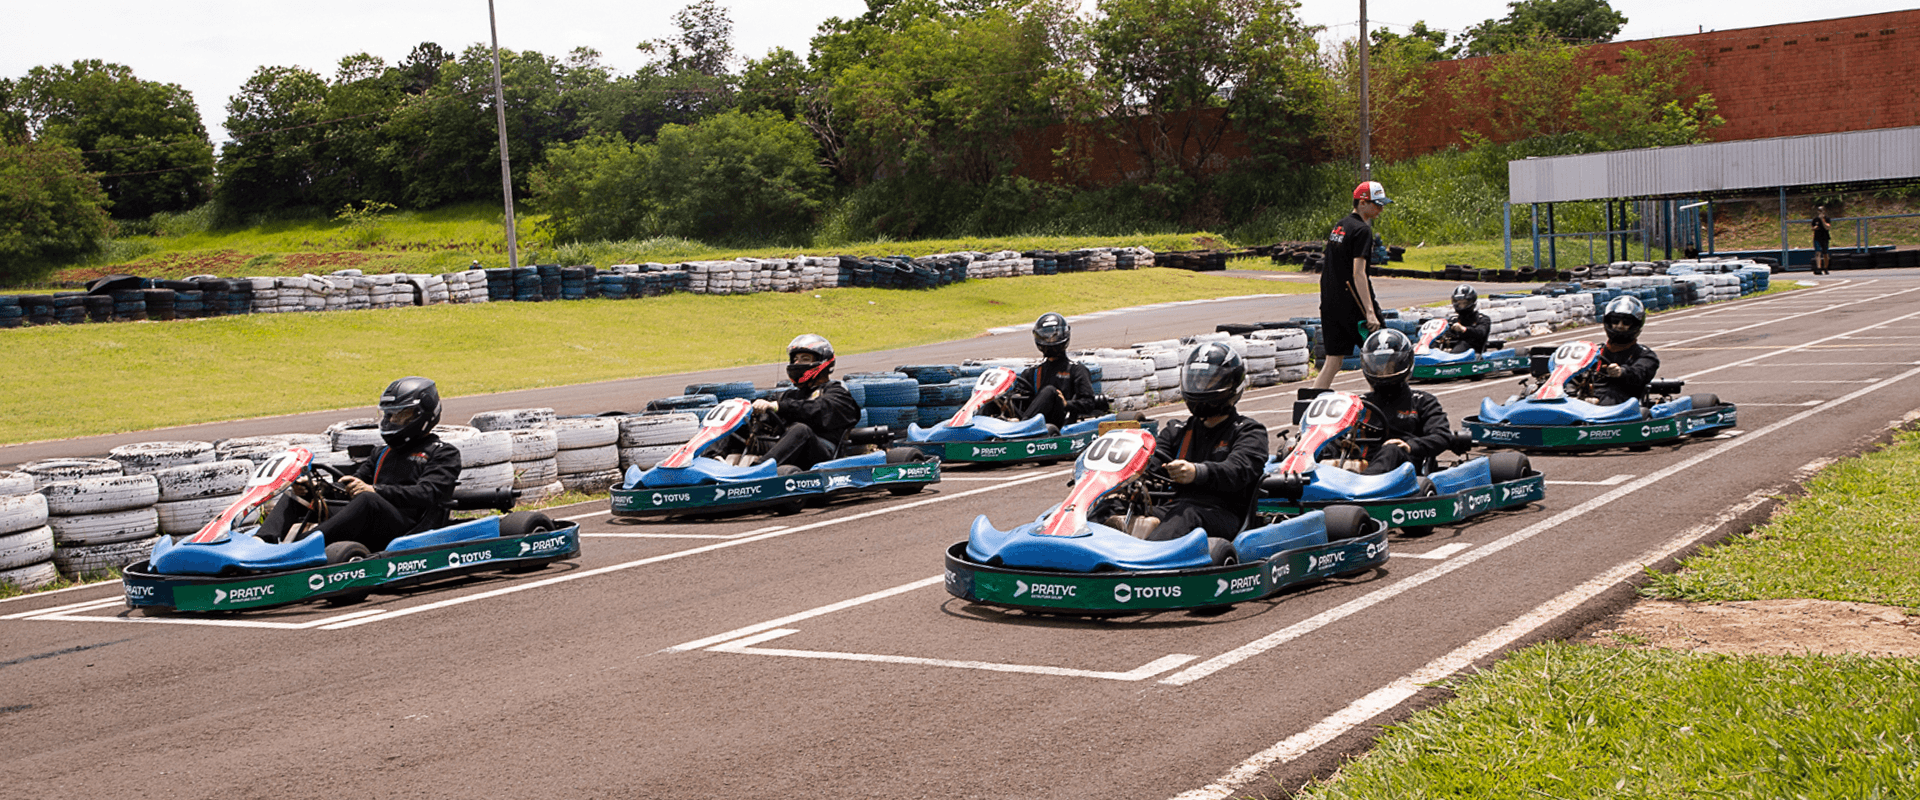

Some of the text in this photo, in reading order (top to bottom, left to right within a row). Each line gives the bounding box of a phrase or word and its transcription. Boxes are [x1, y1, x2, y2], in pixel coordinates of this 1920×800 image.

[980, 371, 1002, 386] 14
[707, 404, 736, 421] 01
[1309, 399, 1348, 418] 06
[1590, 428, 1622, 438] PRATYC
[1036, 442, 1058, 451] TOTUS
[1088, 437, 1136, 465] 05
[256, 456, 287, 478] 11
[727, 485, 762, 497] PRATYC
[796, 479, 821, 488] TOTUS
[663, 493, 690, 502] TOTUS
[1406, 508, 1437, 520] TOTUS
[532, 535, 566, 551] PRATYC
[460, 550, 492, 563] TOTUS
[397, 558, 427, 573] PRATYC
[326, 568, 366, 584] TOTUS
[1230, 573, 1261, 590] PRATYC
[229, 584, 275, 600] PRATYC
[1031, 583, 1077, 597] PRATYC
[1134, 586, 1182, 598] TOTUS
